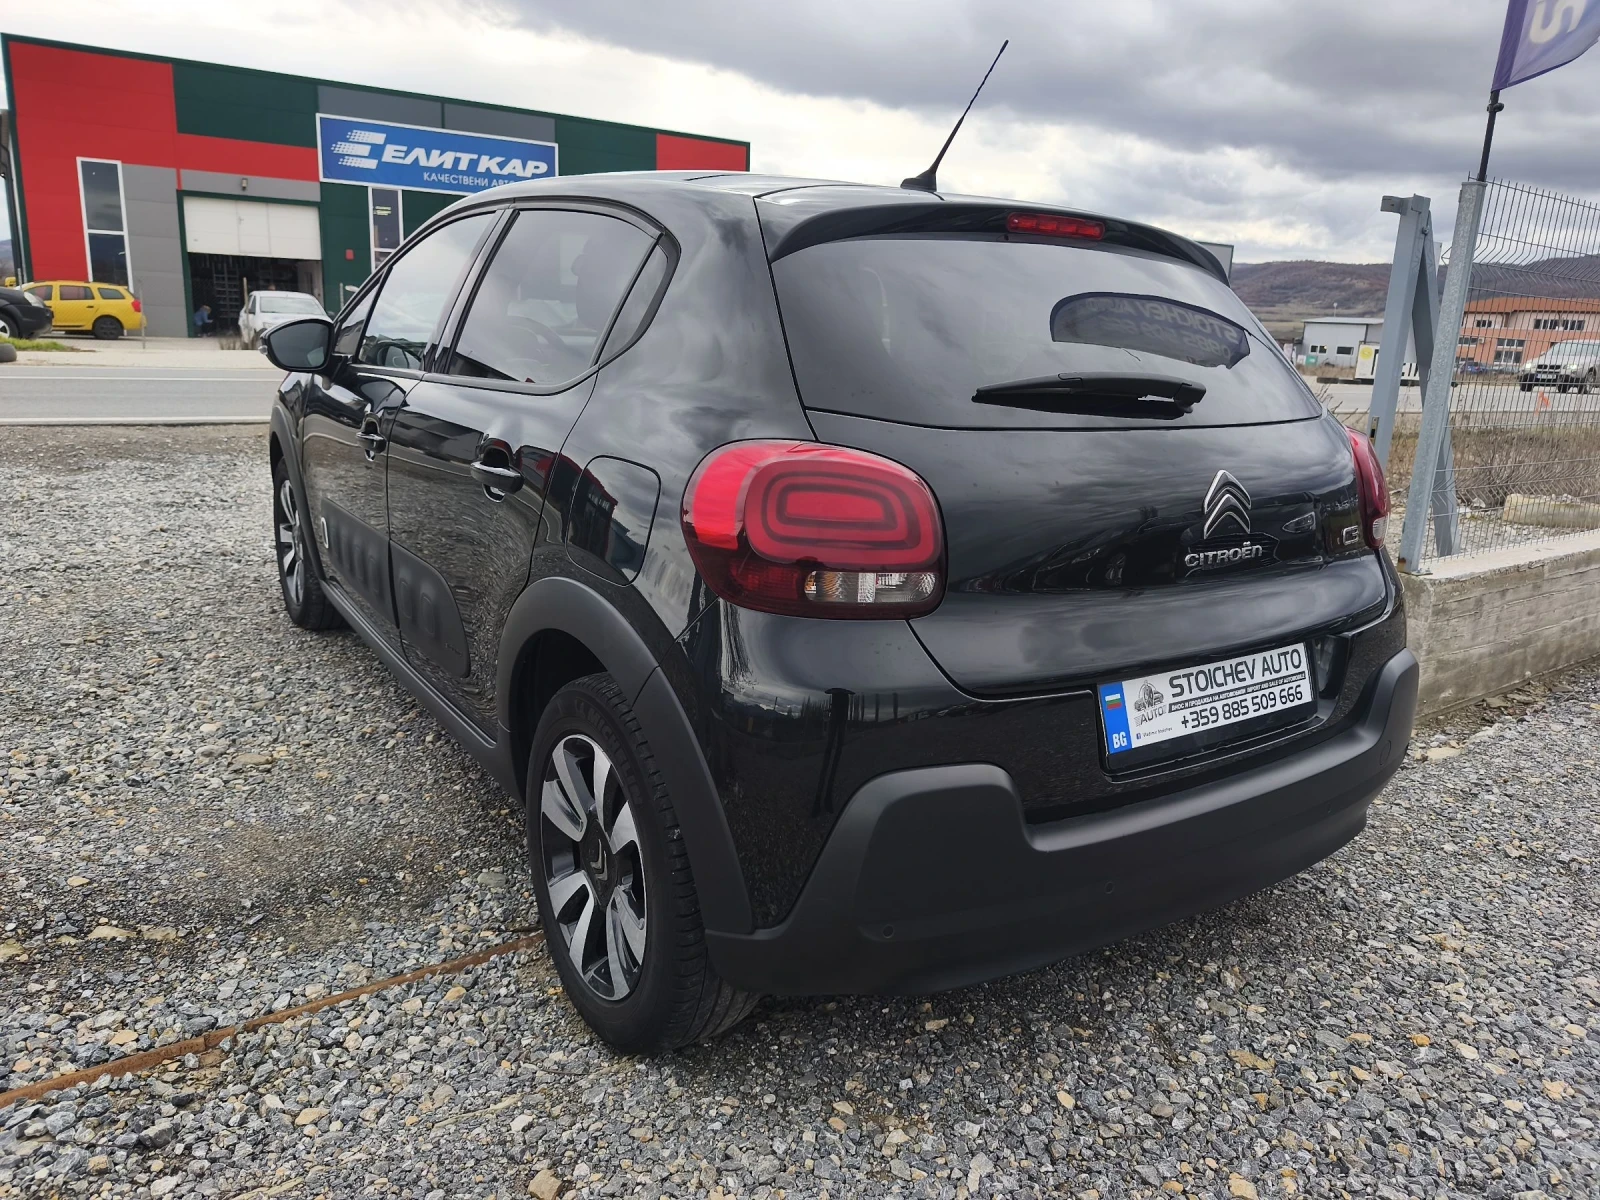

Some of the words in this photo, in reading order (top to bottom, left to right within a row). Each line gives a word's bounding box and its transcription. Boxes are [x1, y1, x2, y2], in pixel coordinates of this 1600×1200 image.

[381, 144, 478, 169] ЕЛИТ
[477, 155, 549, 178] КАР
[423, 171, 489, 187] КАЧЕСТВЕНИ
[1168, 658, 1256, 699] STOICHEV
[1261, 648, 1302, 678] AUTO
[1140, 707, 1164, 726] AUTO
[1181, 706, 1219, 729] +359
[1222, 696, 1250, 721] 885
[1251, 691, 1277, 713] 509
[1279, 684, 1303, 706] 666
[1112, 731, 1128, 749] BG
